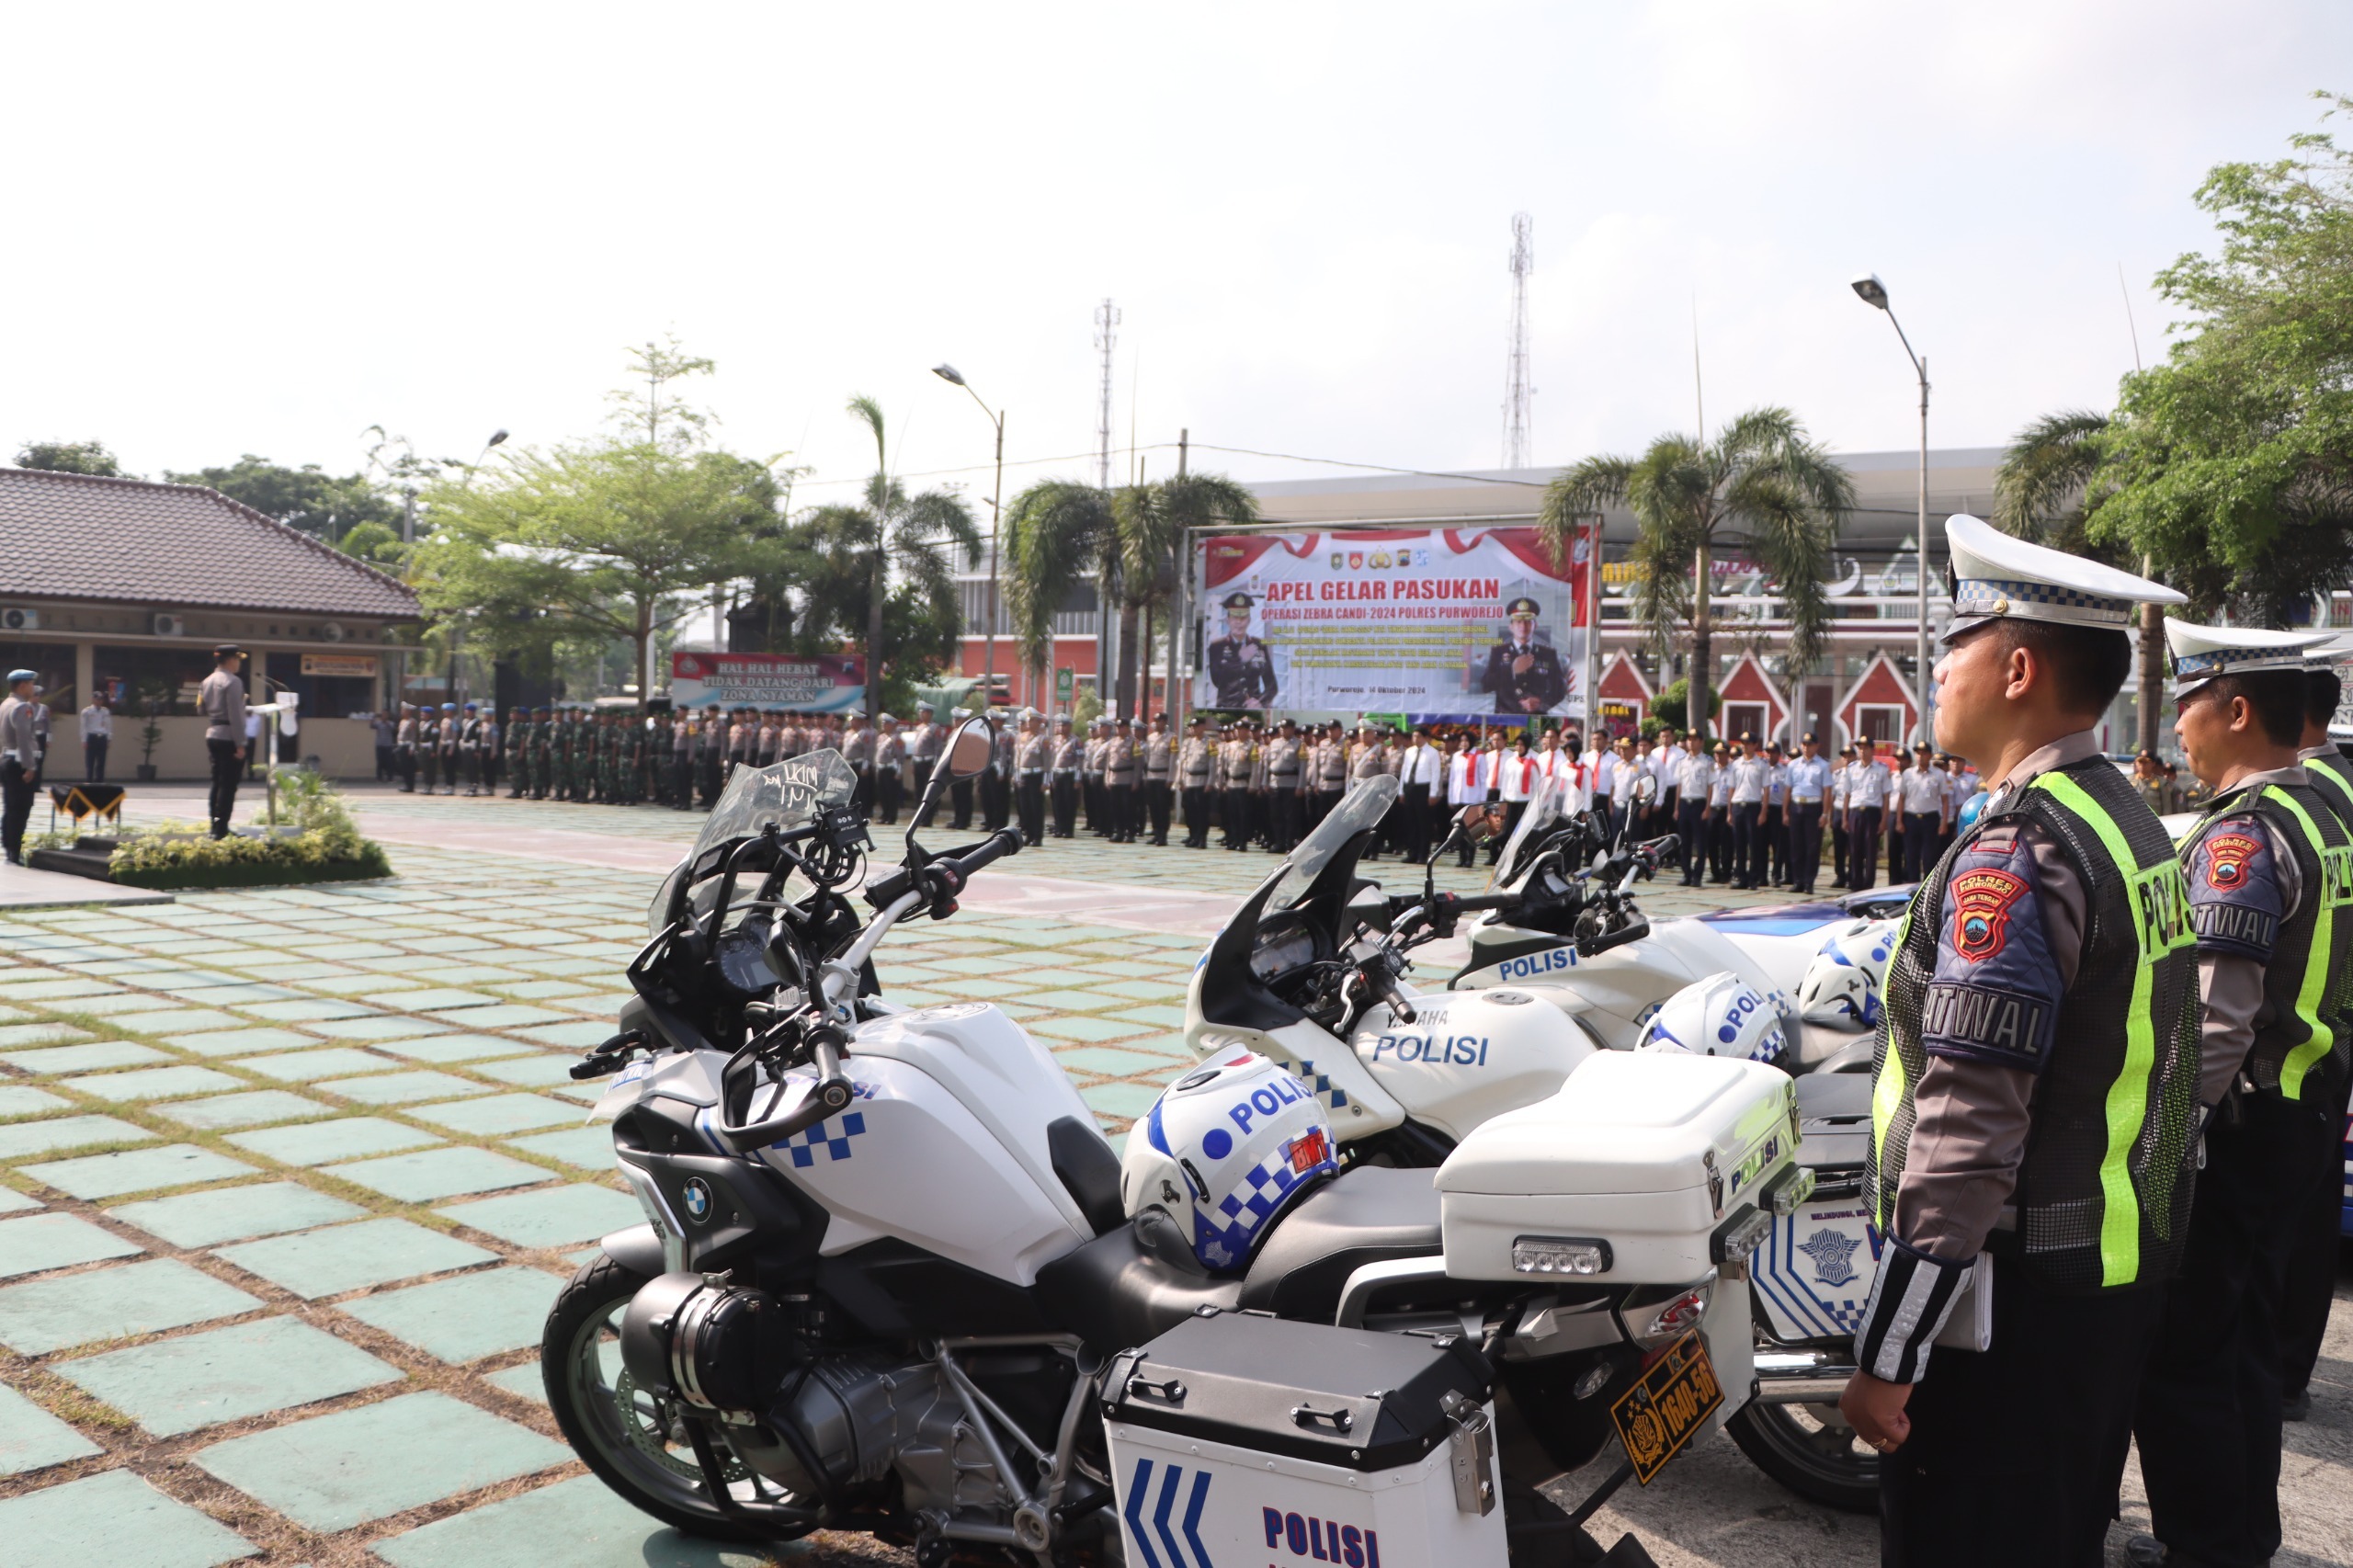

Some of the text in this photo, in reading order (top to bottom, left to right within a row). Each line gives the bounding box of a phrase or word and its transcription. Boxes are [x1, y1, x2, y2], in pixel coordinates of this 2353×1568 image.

[1267, 578, 1499, 602] APEL GELAR PASUKAN
[1261, 608, 1302, 620] OPERASI
[1303, 608, 1334, 619] ZEBRA
[1398, 607, 1437, 619] POLRES
[1438, 606, 1504, 619] PURWOREJO
[718, 663, 819, 675] HAL HAL HEBAT
[703, 676, 835, 689] TIDAK DATANG DARI
[721, 690, 816, 702] ZONA NYAMAN
[1959, 875, 2014, 892] POLRES
[1961, 881, 2008, 894] PURWOREJO
[1499, 948, 1577, 981] POLISI
[1387, 1010, 1449, 1028] YAHA
[1373, 1035, 1488, 1066] POLISI
[1731, 1134, 1779, 1196] POLISI
[1661, 1361, 1716, 1437] 1640-56
[1262, 1506, 1381, 1568] POLISI
